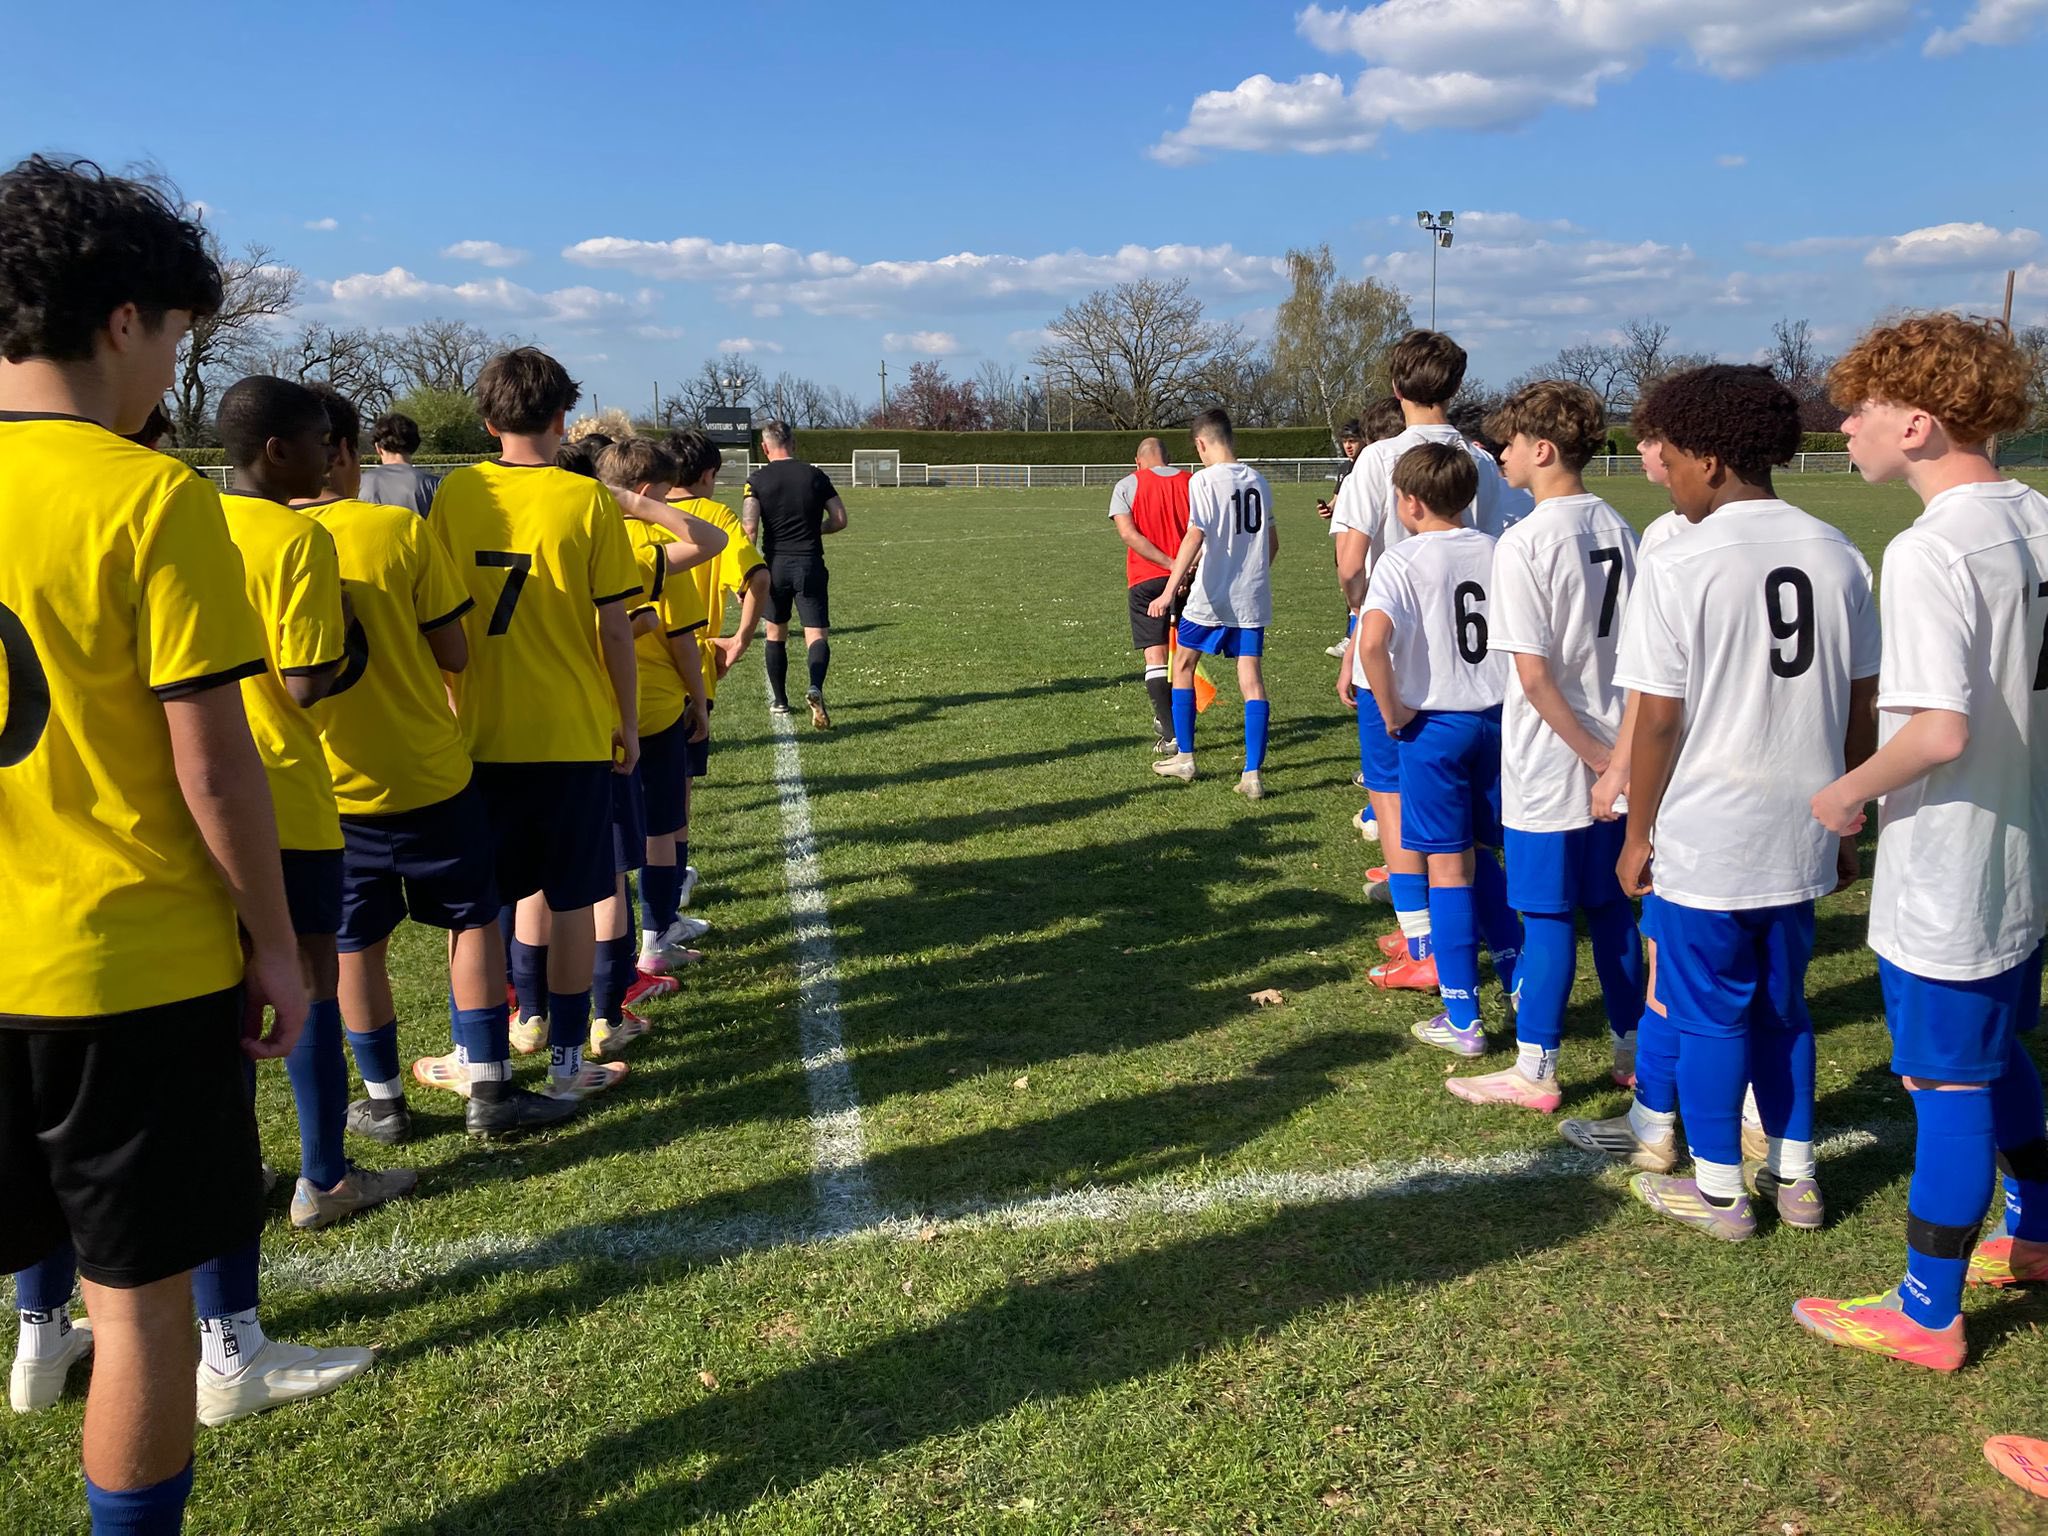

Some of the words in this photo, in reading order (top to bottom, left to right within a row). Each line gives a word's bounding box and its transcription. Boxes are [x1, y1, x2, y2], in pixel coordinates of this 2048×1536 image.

[705, 423, 734, 431] VISITEURS
[1231, 488, 1262, 535] 10
[475, 550, 532, 636] 7
[1454, 580, 1488, 664] 6
[1589, 546, 1622, 638] 7
[1765, 566, 1814, 678] 9
[1804, 1307, 1886, 1342] F50
